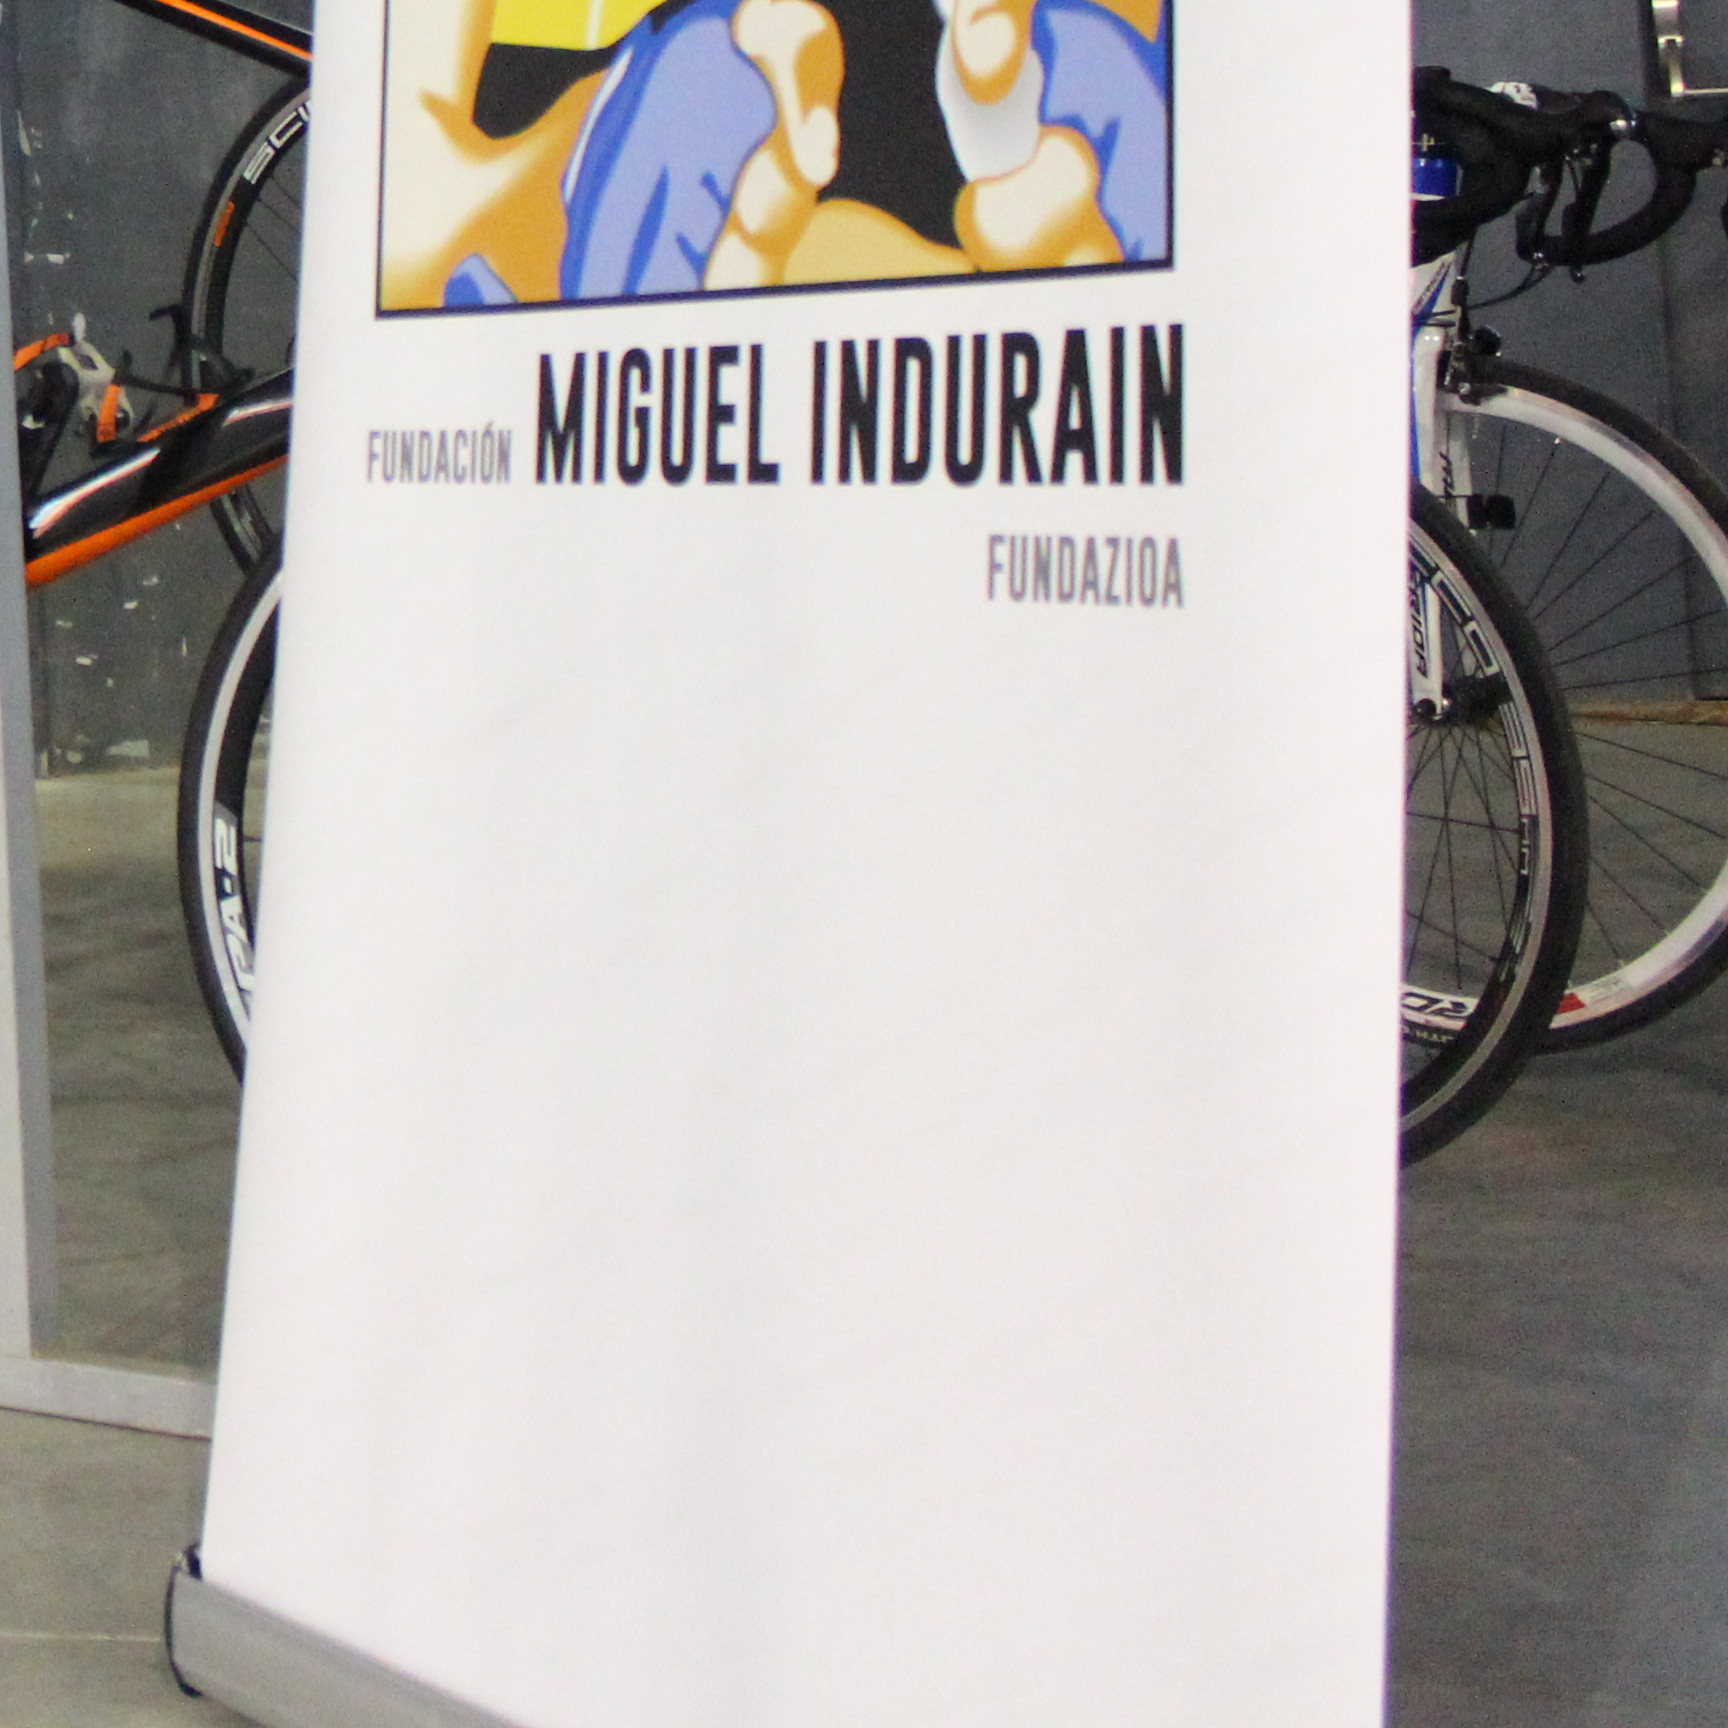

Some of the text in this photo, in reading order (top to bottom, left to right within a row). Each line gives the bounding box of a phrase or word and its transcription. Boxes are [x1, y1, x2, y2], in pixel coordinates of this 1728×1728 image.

[368, 323, 1186, 487] FUNDACIÓN MIGUEL INDURAIN
[986, 533, 1185, 609] FUNDAZIOA
